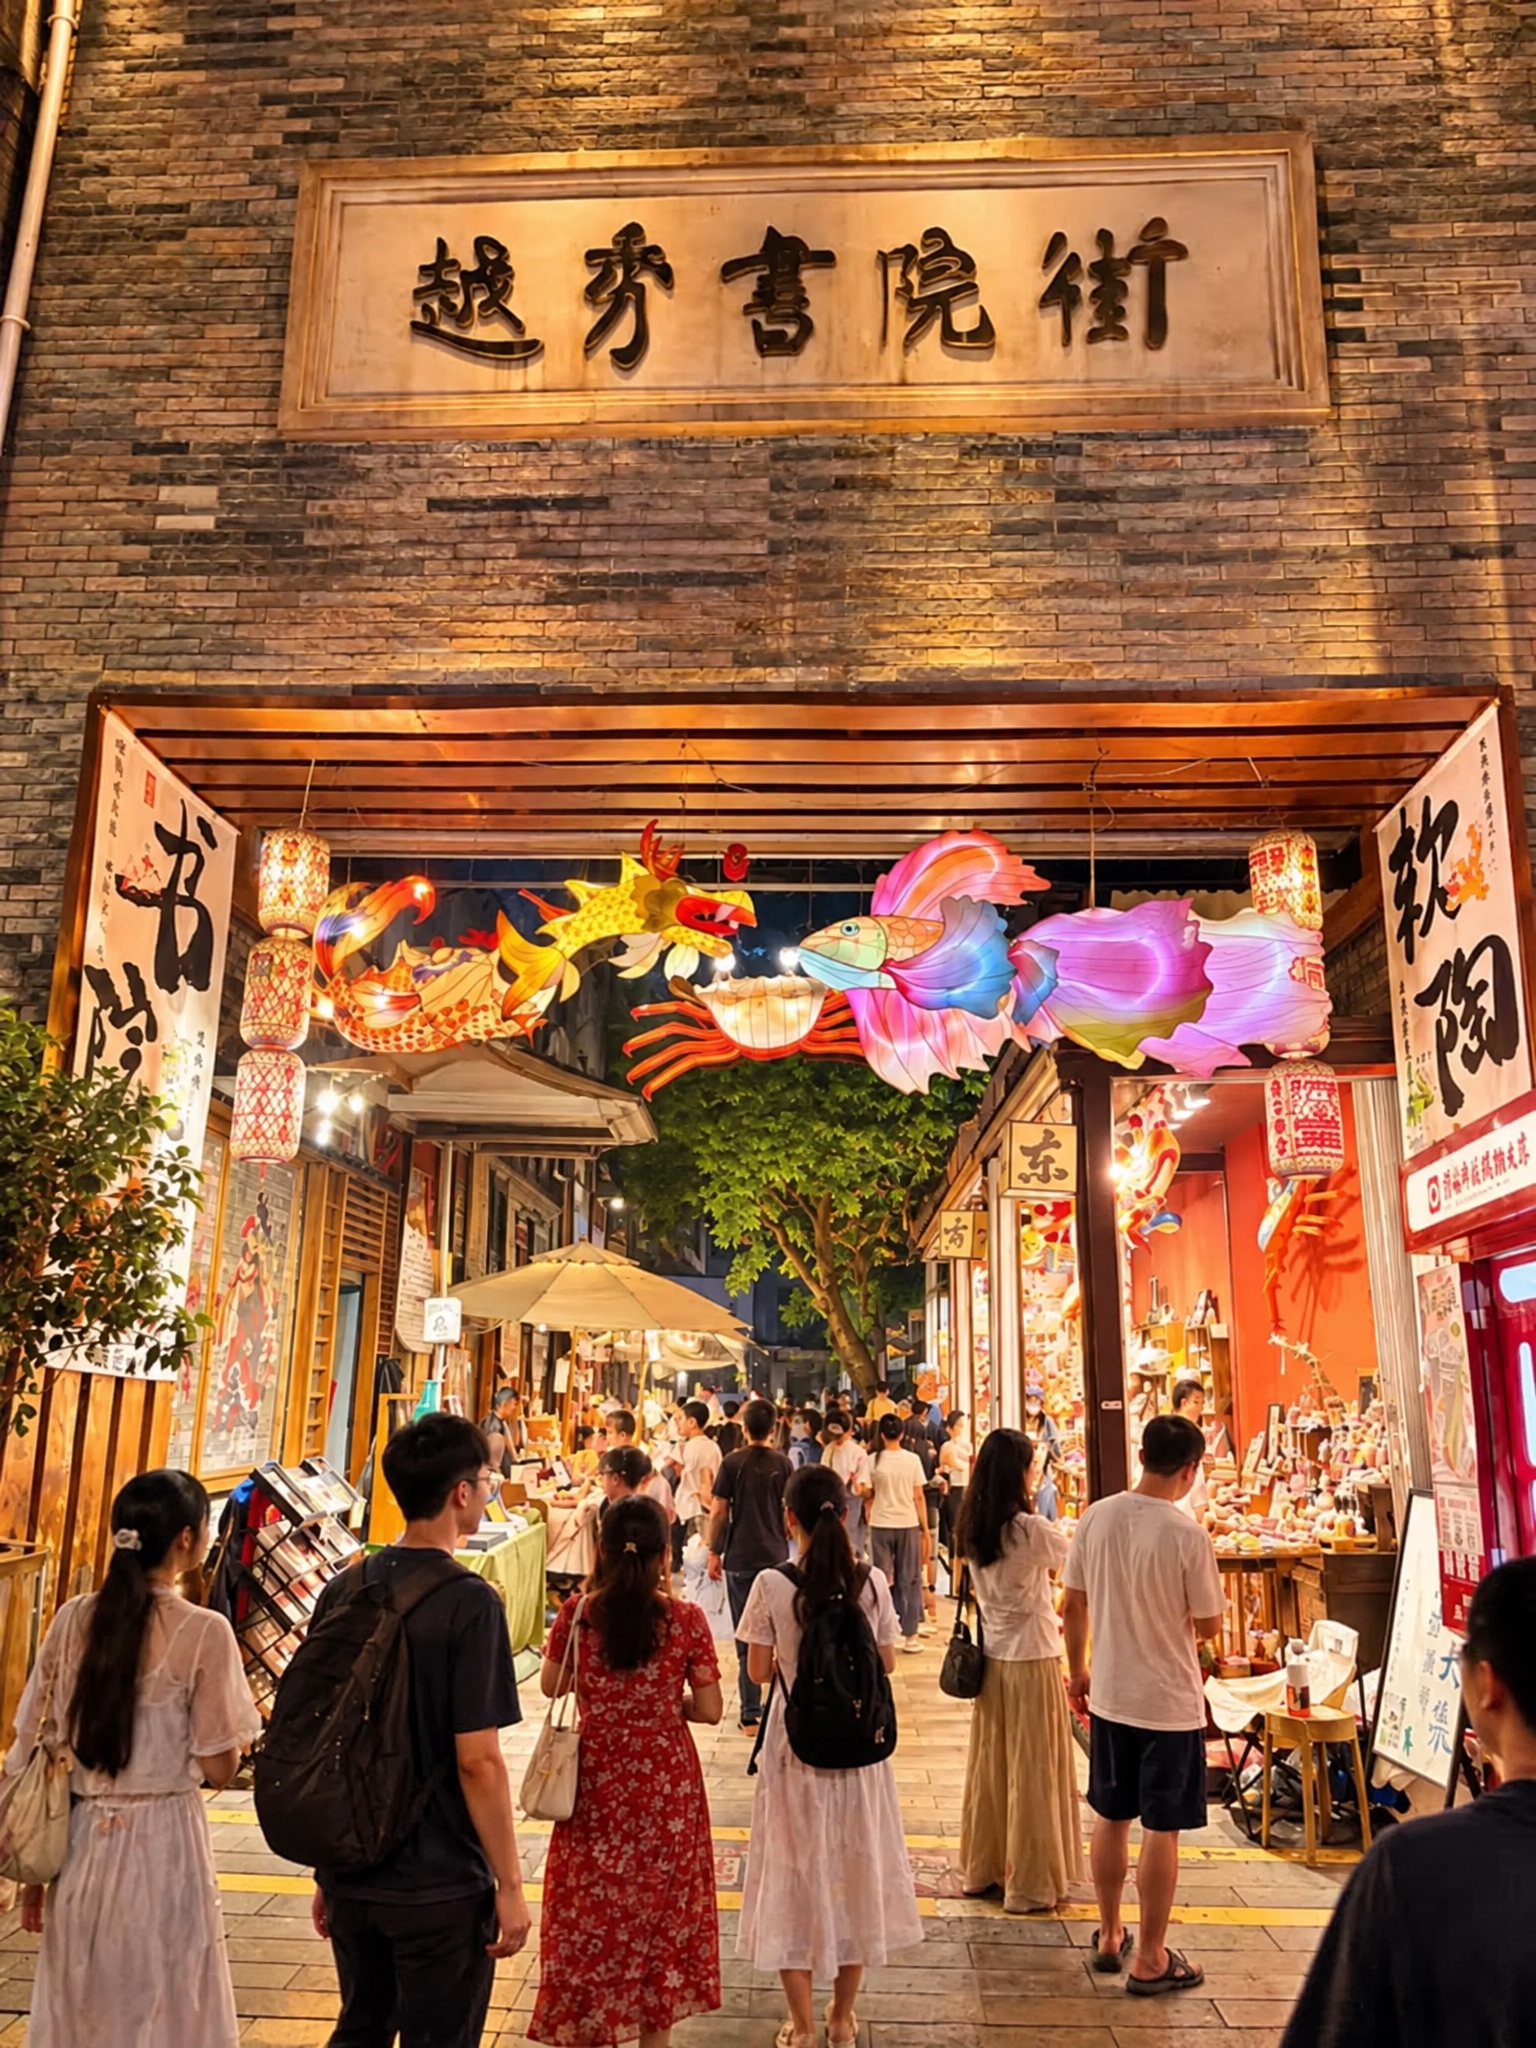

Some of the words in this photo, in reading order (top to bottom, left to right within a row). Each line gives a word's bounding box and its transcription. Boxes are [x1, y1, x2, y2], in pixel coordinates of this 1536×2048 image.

[411, 217, 1189, 370] 越秀書院街
